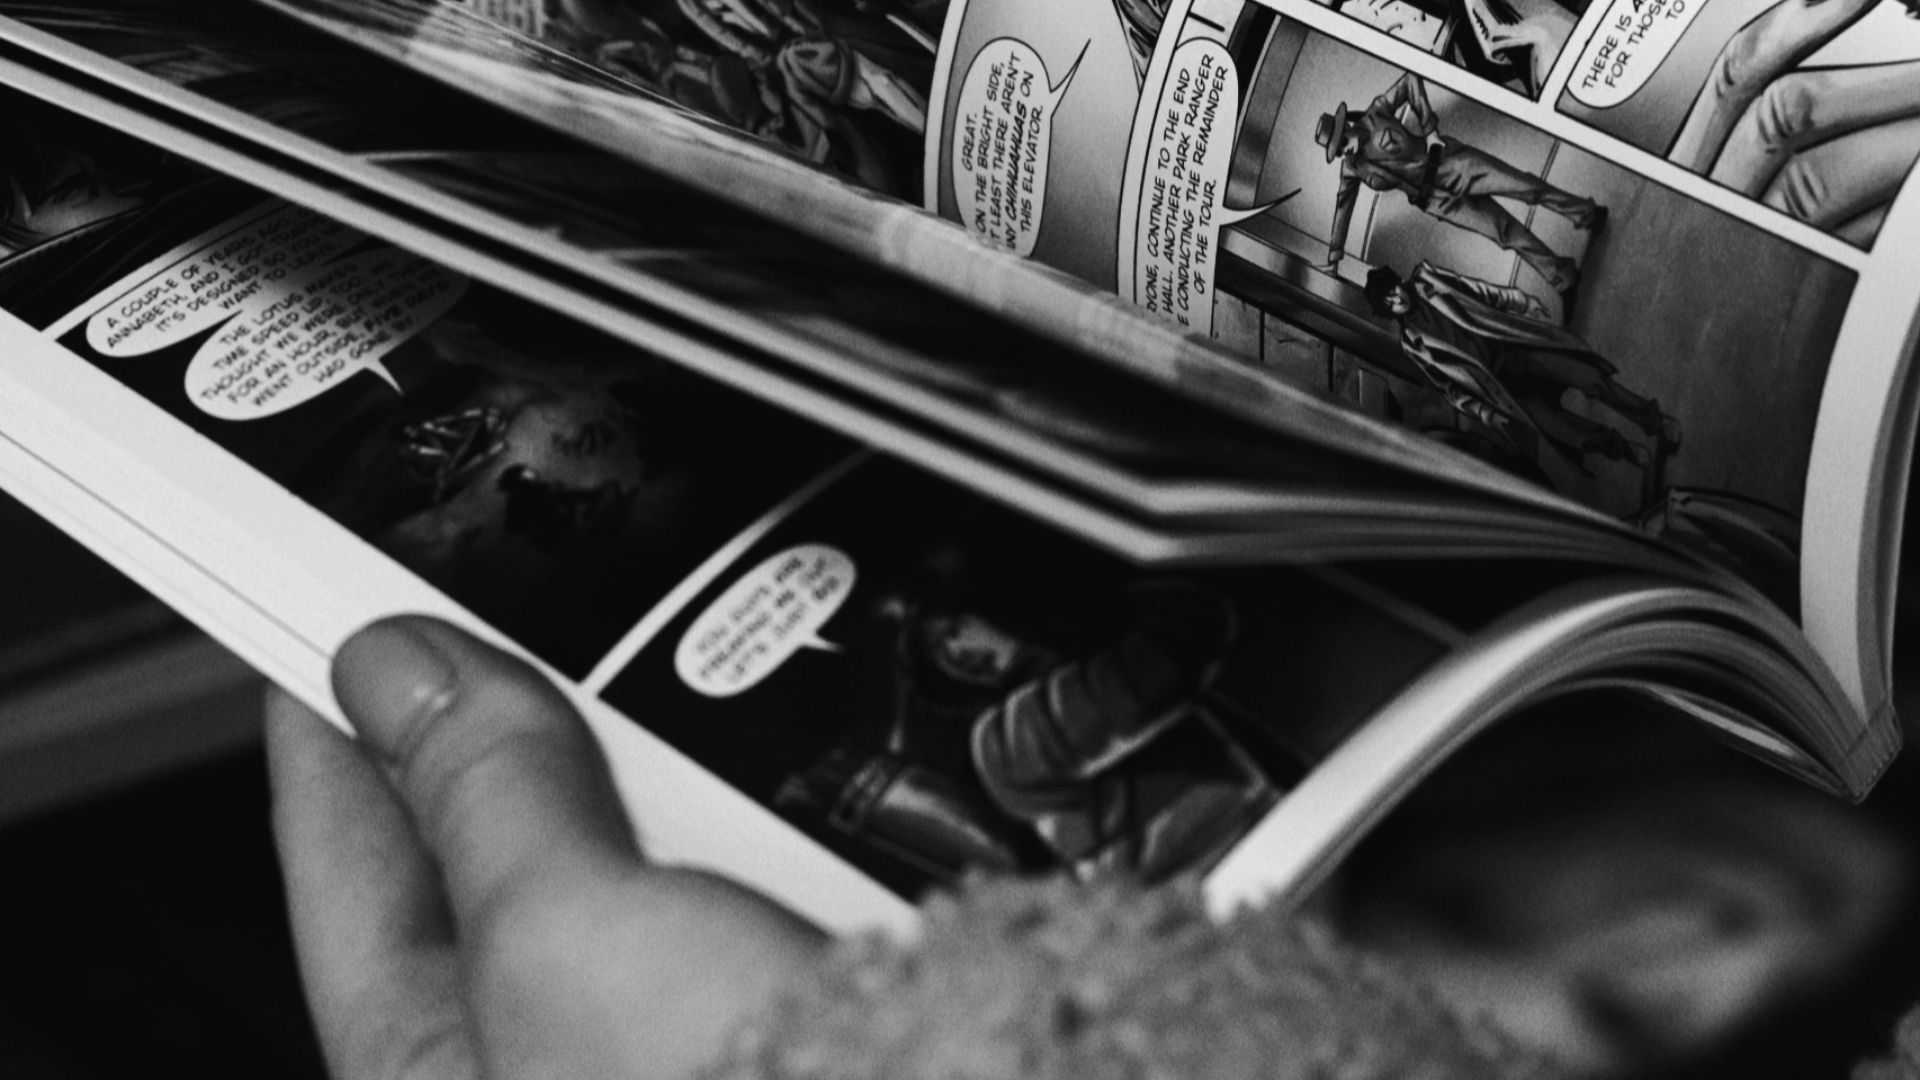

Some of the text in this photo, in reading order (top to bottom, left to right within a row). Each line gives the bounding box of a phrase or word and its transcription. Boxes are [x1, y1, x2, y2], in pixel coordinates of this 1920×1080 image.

[1665, 0, 1685, 19] TO
[1582, 0, 1647, 89] THERE IS A
[1605, 52, 1632, 88] FOR
[1001, 52, 1021, 114] AREN'T
[962, 113, 977, 171] GREAT.
[975, 62, 1005, 232] ON THE BRIGHT SIDE,
[993, 117, 1008, 170] THERE
[1005, 101, 1027, 221] CHIHUAHUAS
[1020, 70, 1034, 97] ON
[1021, 105, 1043, 231] THIS ELEVATOR.
[1148, 176, 1165, 257] CONTINUE
[1158, 148, 1170, 170] TO
[1164, 109, 1179, 141] THE
[1174, 68, 1190, 104] END
[990, 175, 1002, 227] LEAST
[1162, 54, 1214, 314] HALL. ANOTHER PARK RANGER
[1177, 210, 1194, 311] CONDUCTING
[1186, 171, 1200, 202] THE
[1193, 66, 1228, 165] REMAINDER
[1194, 180, 1216, 294] OF THE TOUR.
[106, 317, 119, 330] A
[121, 278, 179, 317] COUPLE
[181, 263, 201, 280] OF
[190, 271, 219, 293] AND
[221, 263, 235, 274] I
[237, 244, 264, 265] GOT
[219, 281, 262, 310] WANT
[263, 268, 286, 283] TO
[155, 312, 186, 333] IT'S
[187, 266, 260, 311] DESIGNED
[219, 325, 250, 345] THE
[251, 292, 302, 325] LOTUS
[201, 349, 270, 393] THOUGHT
[274, 331, 298, 350] WE
[300, 303, 346, 332] WERE
[212, 345, 250, 369] TIME
[251, 311, 299, 345] SPEED
[227, 376, 260, 402] FOR
[265, 360, 287, 378] AN
[254, 373, 293, 406] WENT
[313, 358, 345, 383] HAD
